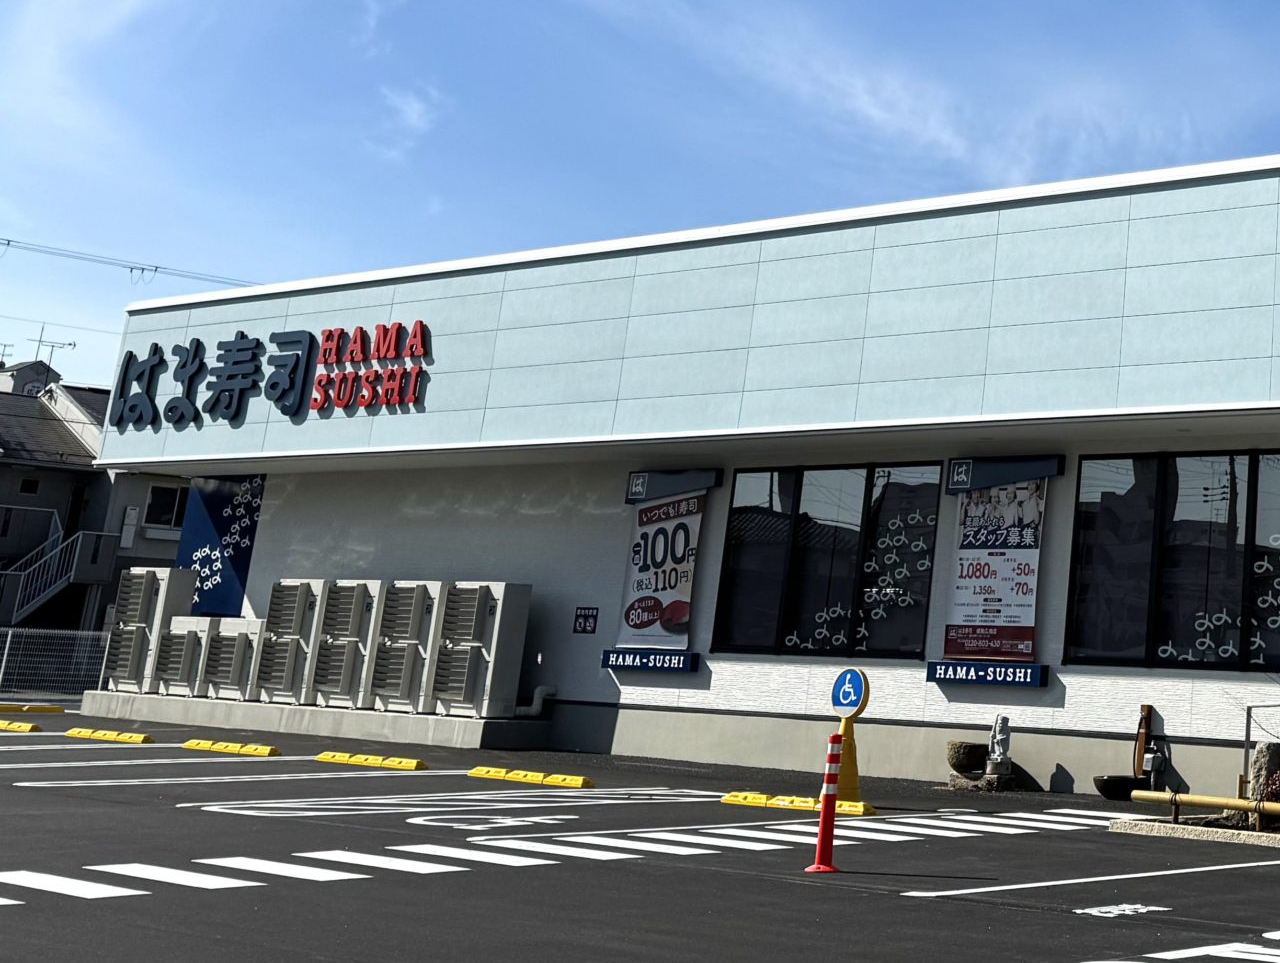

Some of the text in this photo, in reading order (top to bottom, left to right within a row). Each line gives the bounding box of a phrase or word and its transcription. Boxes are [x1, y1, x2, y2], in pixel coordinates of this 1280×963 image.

[316, 320, 426, 365] HAMA
[110, 330, 316, 425] はま寿司
[310, 366, 424, 411] SUSHI
[953, 463, 967, 482] は
[632, 477, 643, 493] は
[963, 527, 1035, 546] スタッフ募集
[958, 562, 997, 580] 1,080円
[609, 653, 685, 668] HAMA-SUSHI
[936, 665, 1032, 682] HAMA-SUSHI
